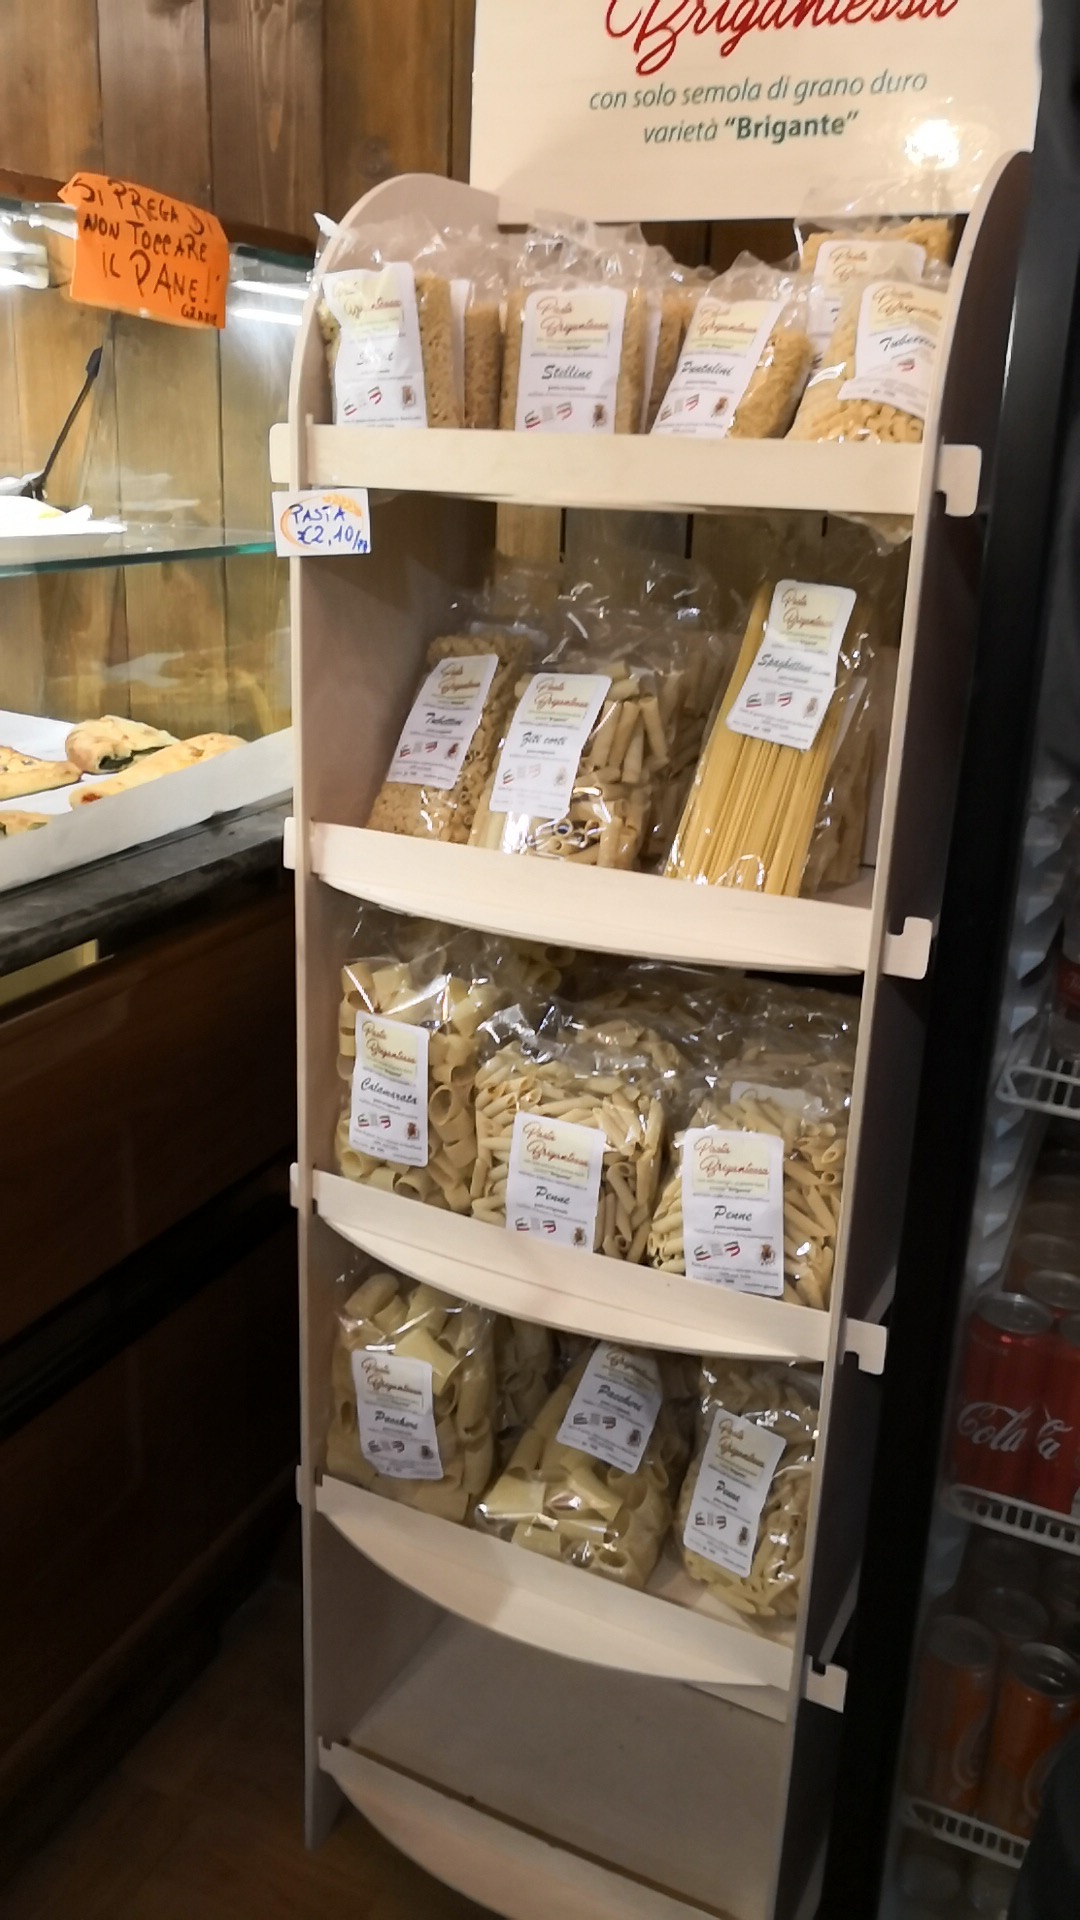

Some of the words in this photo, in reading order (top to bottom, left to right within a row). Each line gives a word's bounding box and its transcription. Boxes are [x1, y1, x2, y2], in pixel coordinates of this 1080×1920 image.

[589, 89, 626, 110] con
[633, 82, 676, 108] solo
[682, 77, 761, 106] semola
[768, 76, 790, 101] di
[794, 75, 864, 104] grano
[870, 69, 928, 94] duro
[643, 119, 718, 145] varietà
[73, 178, 103, 206] SI
[108, 180, 179, 223] PREGA
[84, 213, 120, 240] NON
[126, 220, 207, 262] TOCCARE
[102, 251, 121, 278] IL
[542, 364, 592, 381] Stelline
[289, 504, 345, 524] PASTA
[520, 731, 542, 747] Ziti
[360, 1077, 419, 1106] Calamarata
[693, 1135, 730, 1156] Pasta
[535, 1185, 571, 1205] Penne
[713, 1205, 753, 1222] Penne
